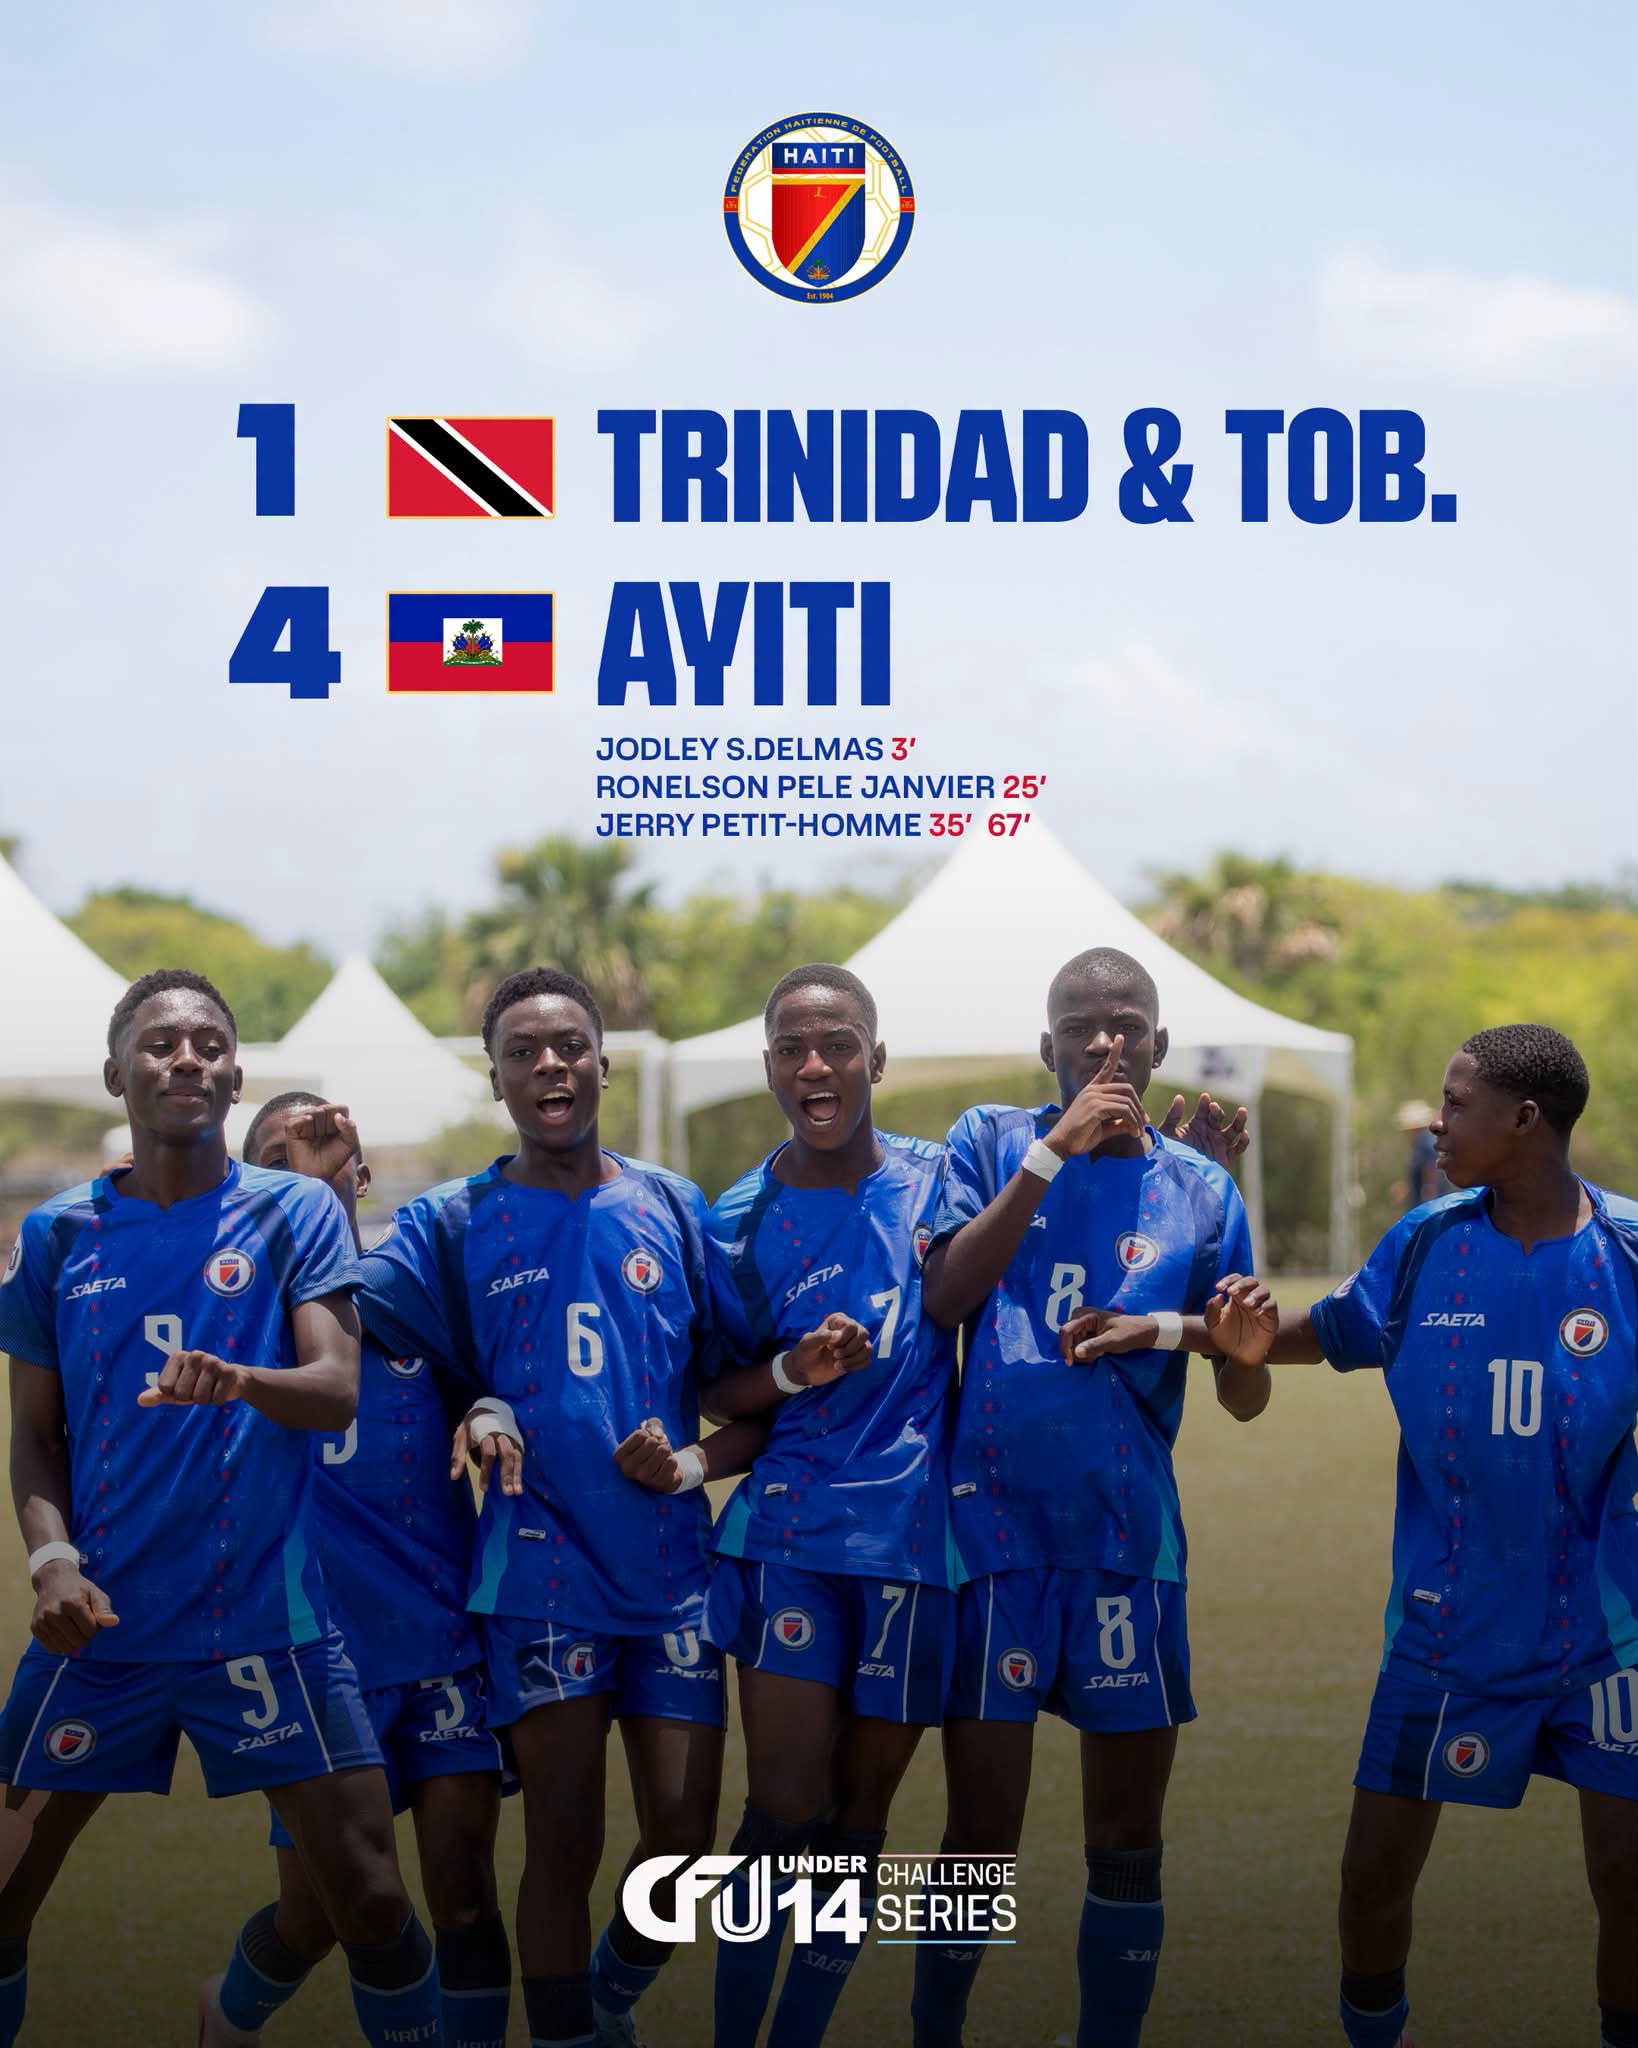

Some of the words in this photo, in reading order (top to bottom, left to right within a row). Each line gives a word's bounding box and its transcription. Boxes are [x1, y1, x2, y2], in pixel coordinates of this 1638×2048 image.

[65, 1276, 127, 1300] SAETA
[486, 1267, 550, 1297] SAETA
[783, 1263, 844, 1308] SAETA
[1044, 1262, 1087, 1335] 8
[566, 1302, 604, 1377] 6
[869, 1284, 901, 1359] 7
[1419, 1313, 1486, 1327] SAETA
[1488, 1358, 1544, 1438] 10
[870, 1584, 908, 1660] 7
[1096, 1595, 1136, 1669] 8
[225, 1654, 280, 1730] 9
[1082, 1671, 1150, 1689] SAETA
[232, 1720, 304, 1755] SAETA
